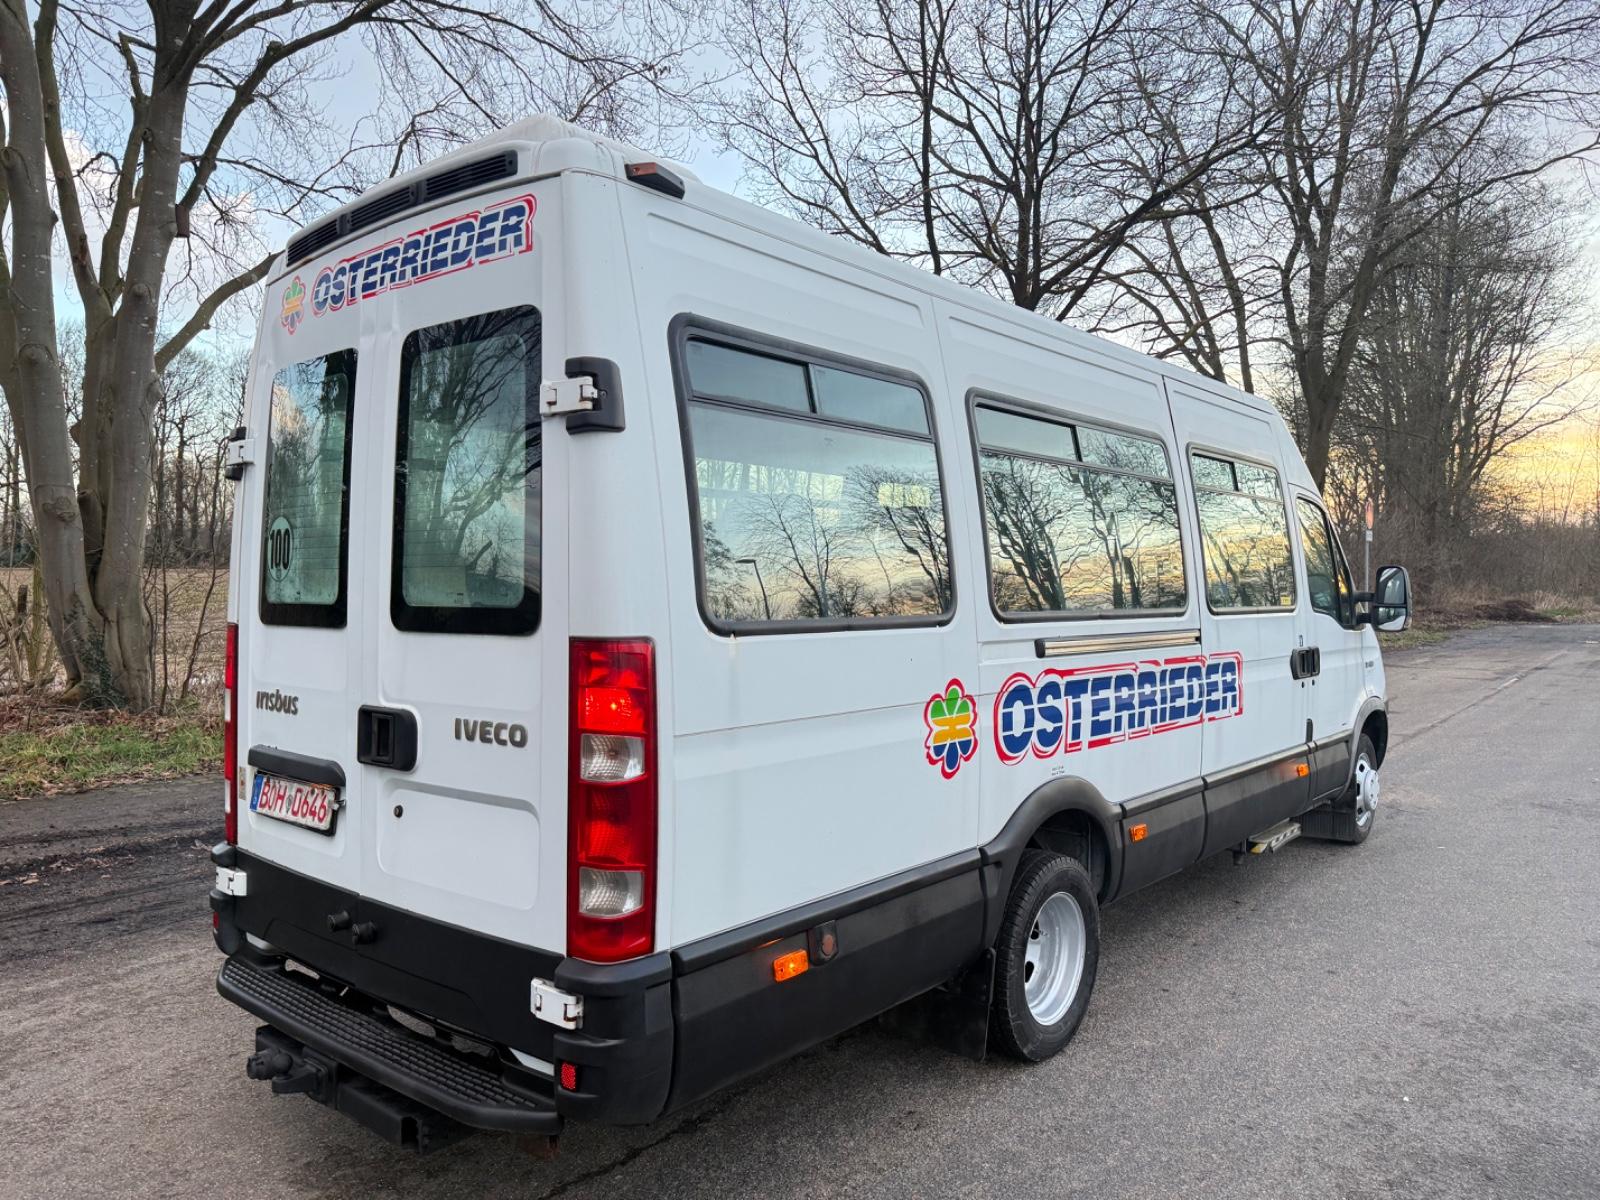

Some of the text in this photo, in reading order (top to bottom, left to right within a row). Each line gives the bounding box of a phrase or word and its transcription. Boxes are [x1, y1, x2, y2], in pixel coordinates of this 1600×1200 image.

[313, 204, 528, 312] OSTERRIEDER
[269, 528, 291, 570] 100
[256, 688, 299, 716] irisbus
[1001, 660, 1238, 755] OSTERRIEDER
[454, 717, 529, 748] IVECO
